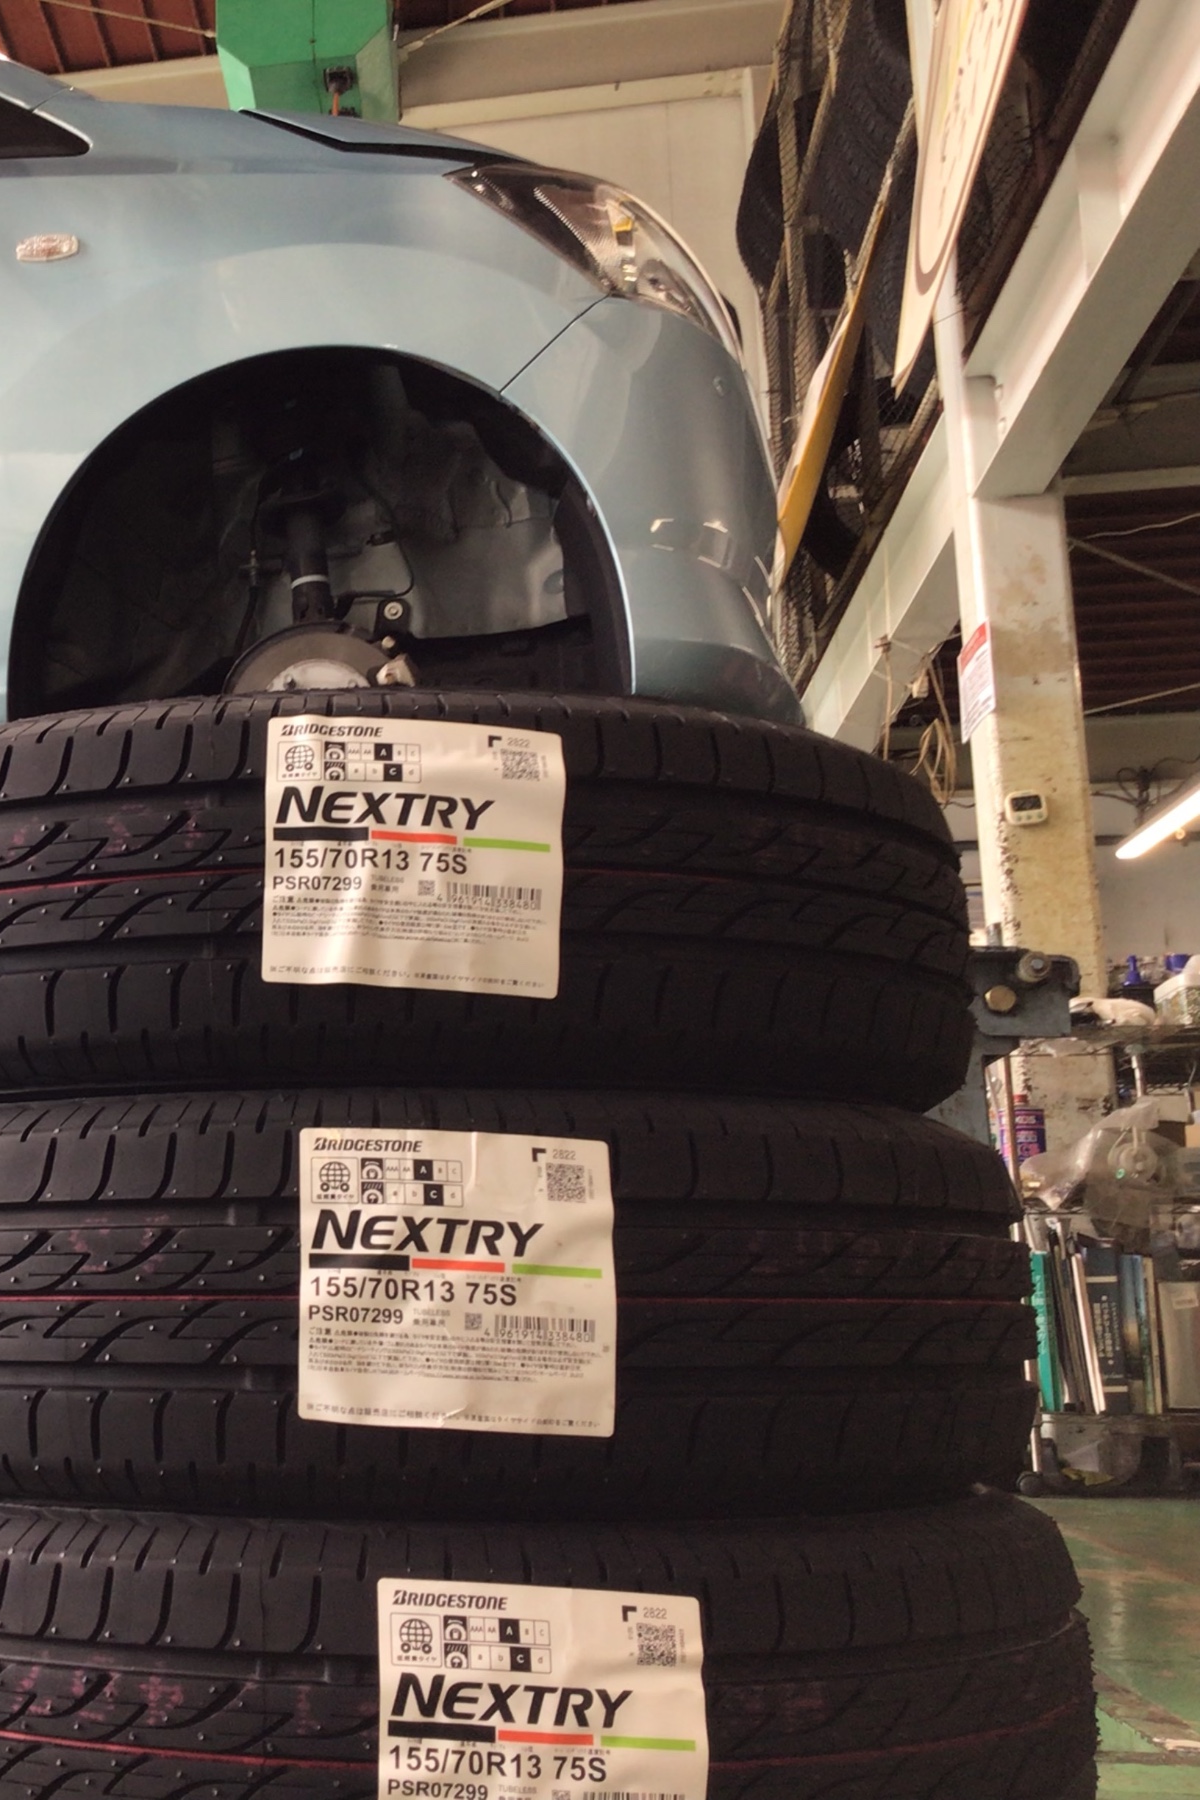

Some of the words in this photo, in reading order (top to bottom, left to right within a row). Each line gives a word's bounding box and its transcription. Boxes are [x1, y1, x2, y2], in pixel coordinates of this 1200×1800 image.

[280, 723, 384, 738] BRIDGESTONE
[379, 748, 388, 757] A
[275, 785, 495, 831] NEXTRY
[274, 848, 410, 872] 155/70R13
[419, 852, 468, 875] 75S
[272, 875, 362, 891] PSR07299
[436, 894, 443, 903] 4
[313, 1137, 423, 1152] BRIDGESTONE
[419, 1165, 428, 1174] A
[429, 1190, 438, 1199] C
[311, 1209, 545, 1257] NEXTRY
[309, 1276, 455, 1302] 155/70R13
[466, 1282, 518, 1307] 75S
[308, 1305, 404, 1325] PSR07299
[483, 1327, 491, 1337] 4
[392, 1589, 508, 1611] BRIDGESTONE
[506, 1625, 514, 1636] A
[516, 1654, 525, 1663] C
[390, 1672, 633, 1728] NEXTRY
[388, 1744, 542, 1779] 155/70R13
[553, 1755, 608, 1783] 75S
[387, 1779, 488, 1800] PSR07299
